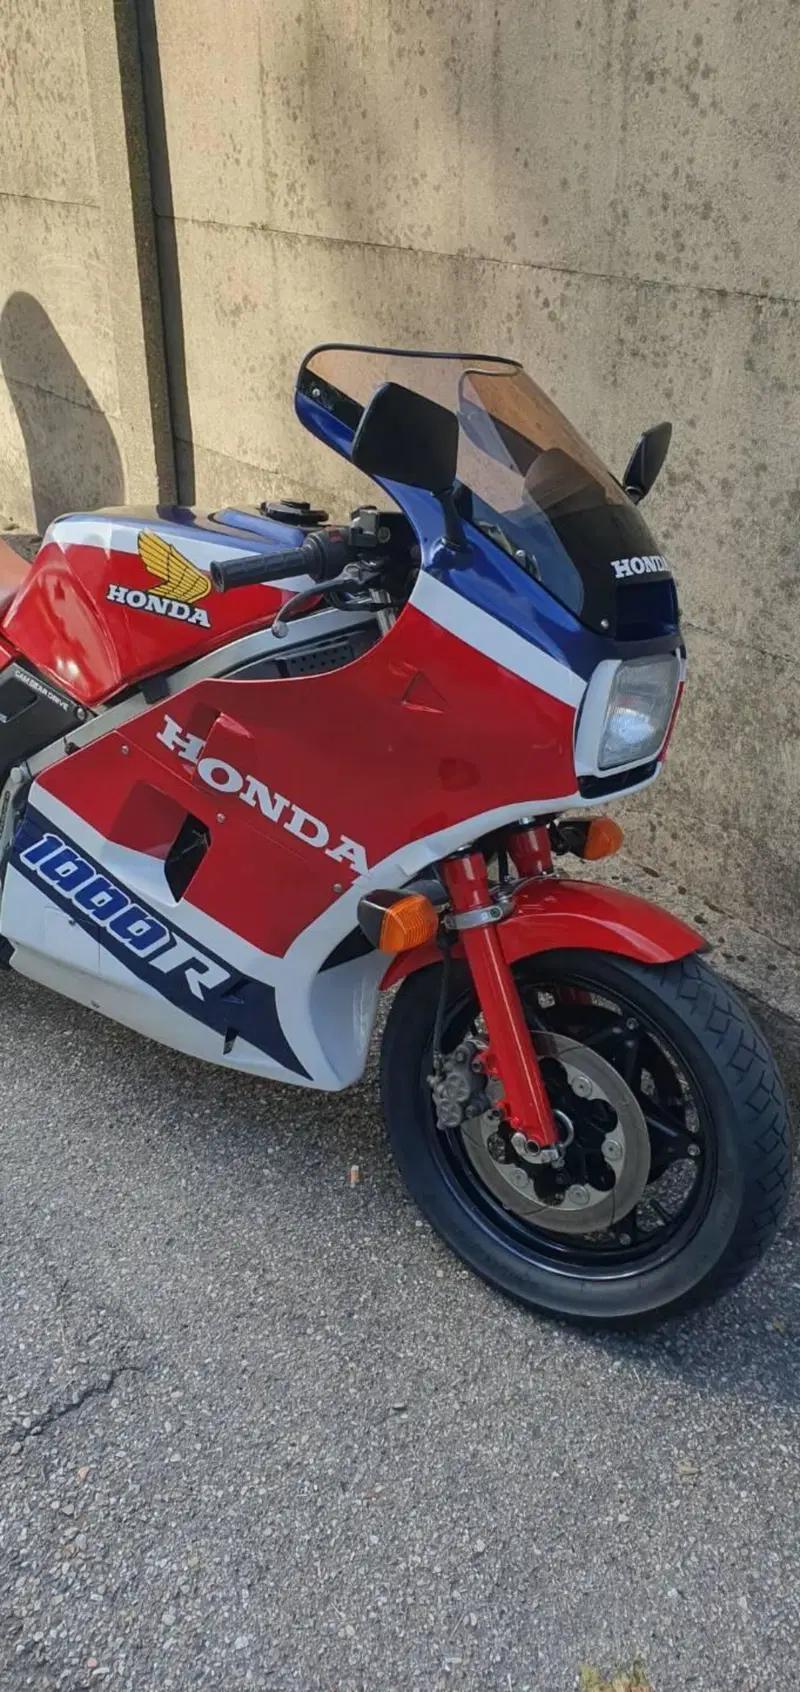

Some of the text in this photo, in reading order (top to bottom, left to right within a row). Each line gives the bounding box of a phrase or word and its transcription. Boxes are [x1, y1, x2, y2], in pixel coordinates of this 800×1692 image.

[107, 584, 211, 628] HONDA
[14, 669, 69, 712] CAM GEAR DRIVE
[156, 715, 372, 880] HONDA
